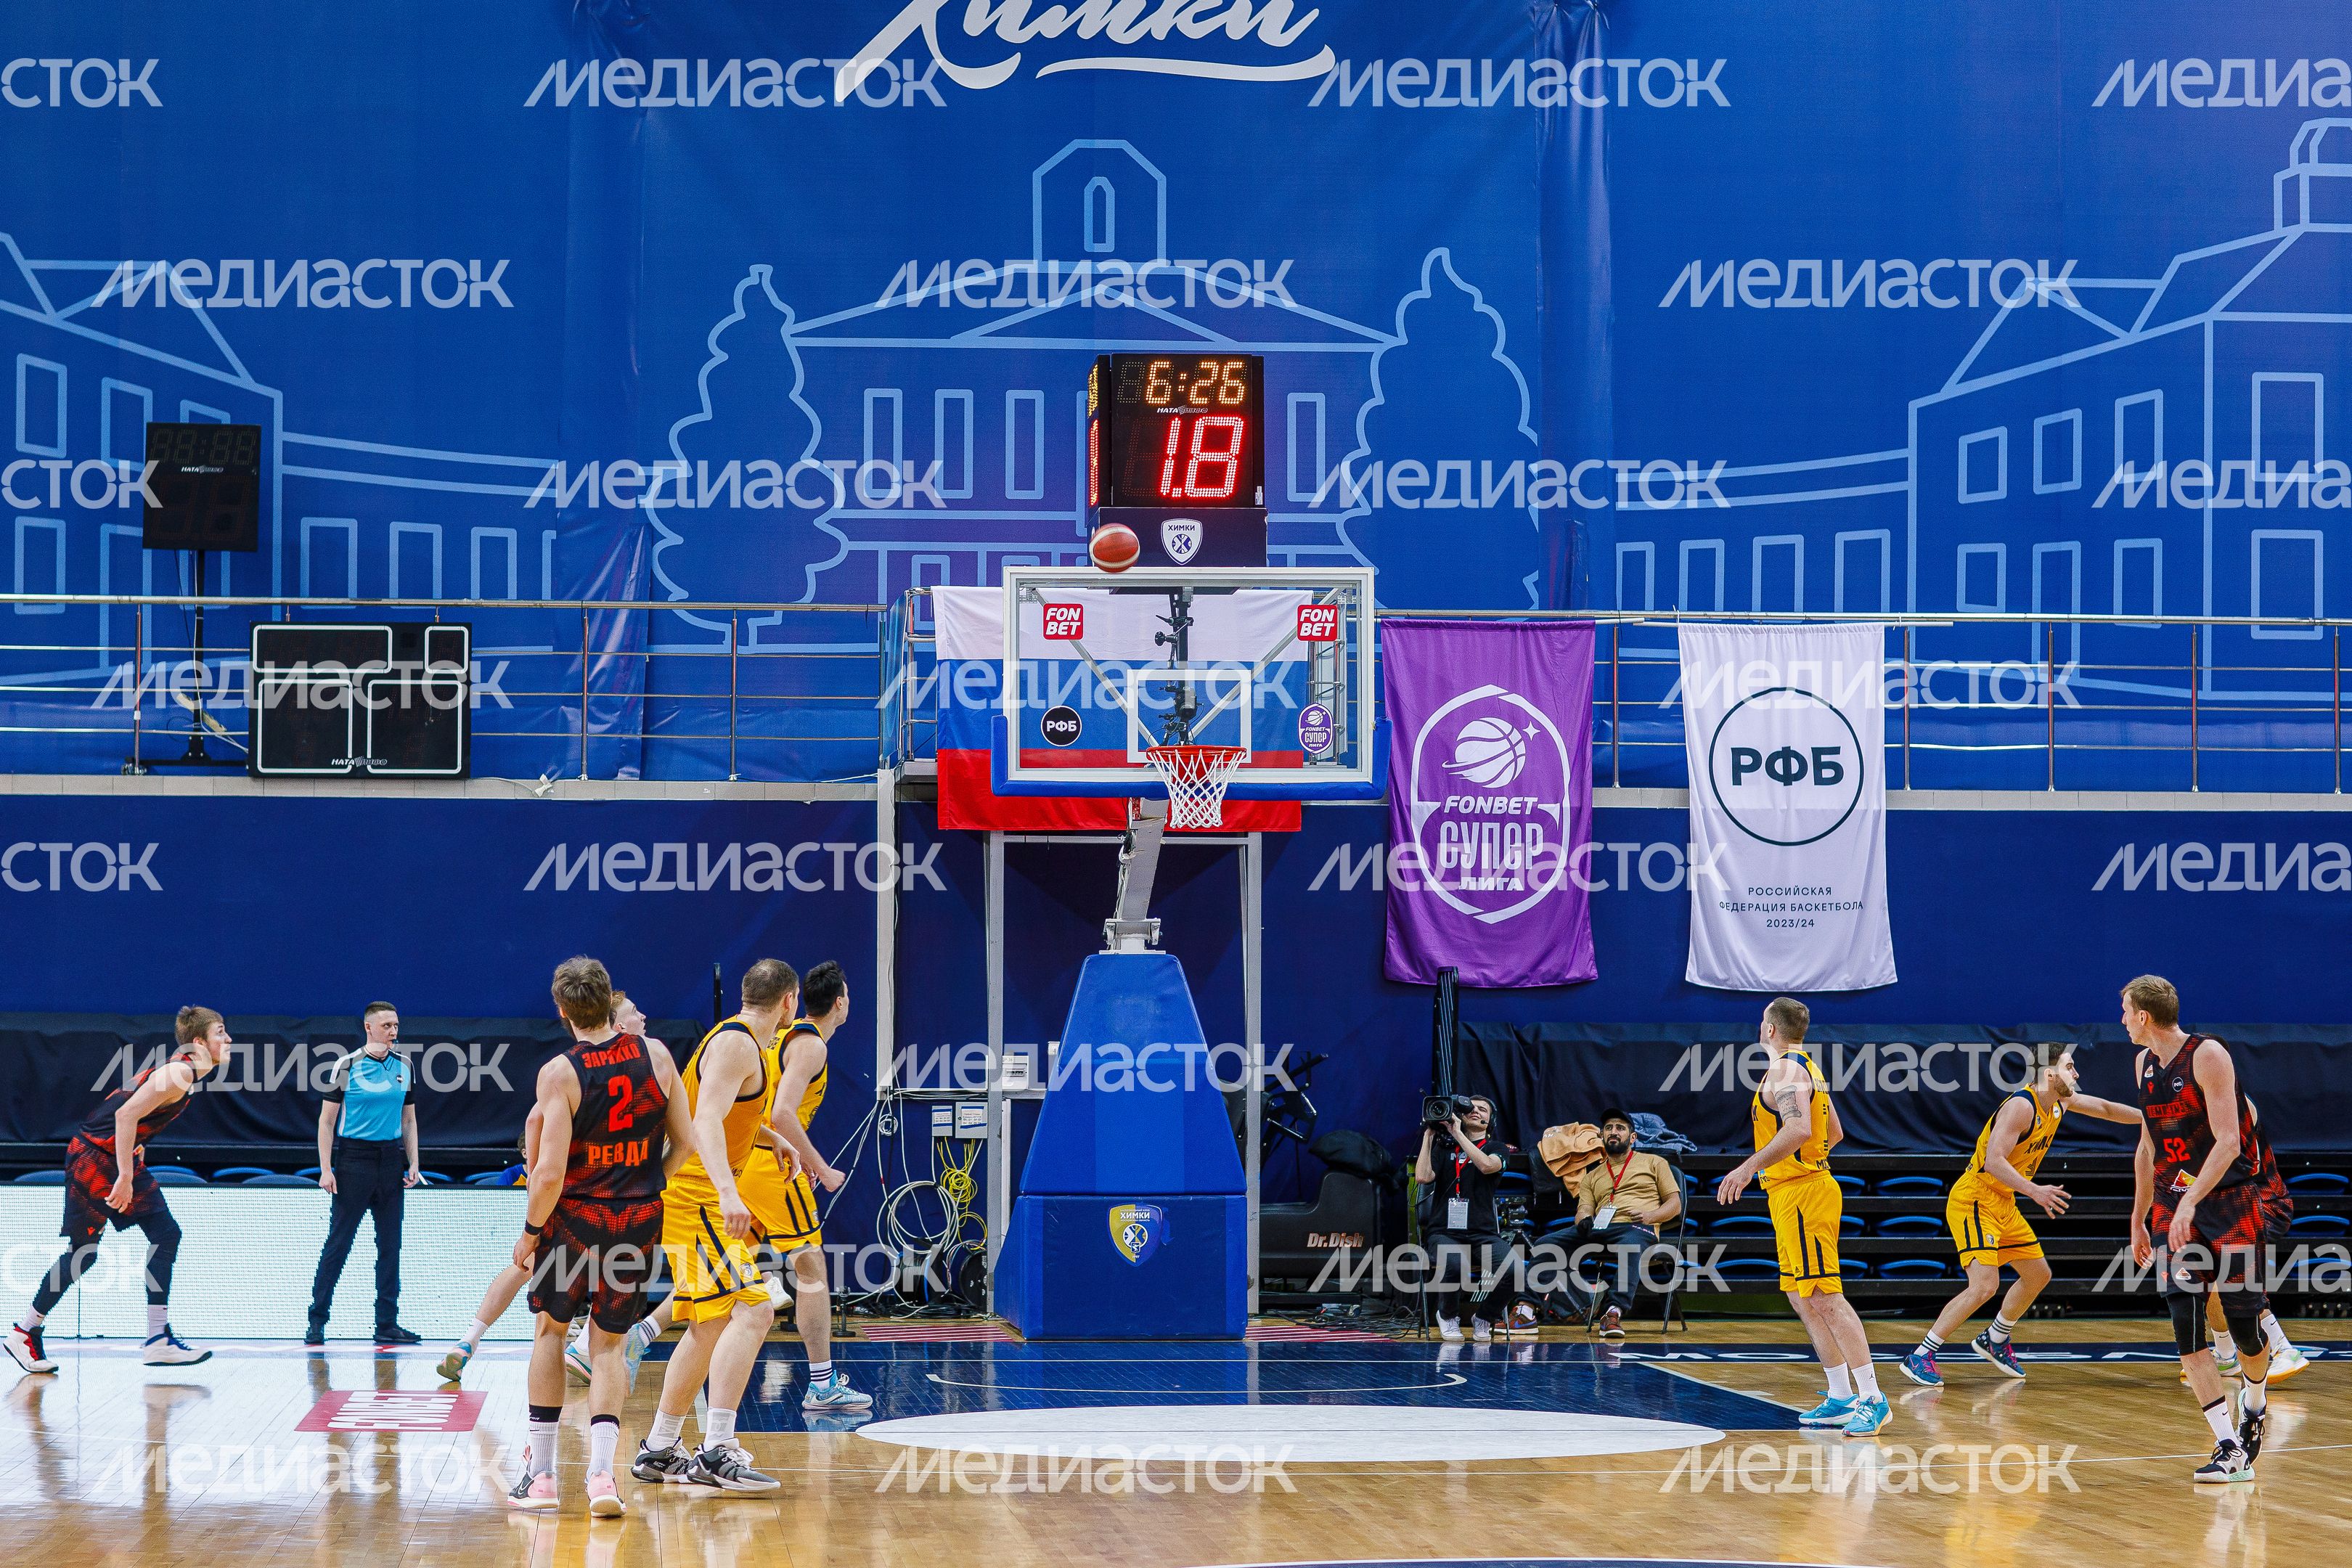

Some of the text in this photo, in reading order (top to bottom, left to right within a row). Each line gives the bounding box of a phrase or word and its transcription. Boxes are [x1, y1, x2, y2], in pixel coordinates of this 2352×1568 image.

[1146, 361, 1245, 404] 6:26
[1161, 416, 1244, 498] 1.8
[1045, 608, 1082, 621] FON
[1299, 608, 1336, 622] FON
[1045, 621, 1081, 635] BET
[1299, 623, 1335, 637] BET
[1046, 720, 1077, 732] РФБ
[1730, 746, 1845, 787] РФБ
[1443, 795, 1538, 815] FONBET
[1458, 876, 1524, 891] ЛИГА
[1748, 885, 1832, 896] РОССИЙСКАЯ
[1719, 900, 1863, 913] ФЕДЕРАЦИЯ БАСКЕТБОЛА
[1766, 919, 1816, 928] 2023/24
[608, 1074, 633, 1132] 2
[2163, 1138, 2192, 1163] 52
